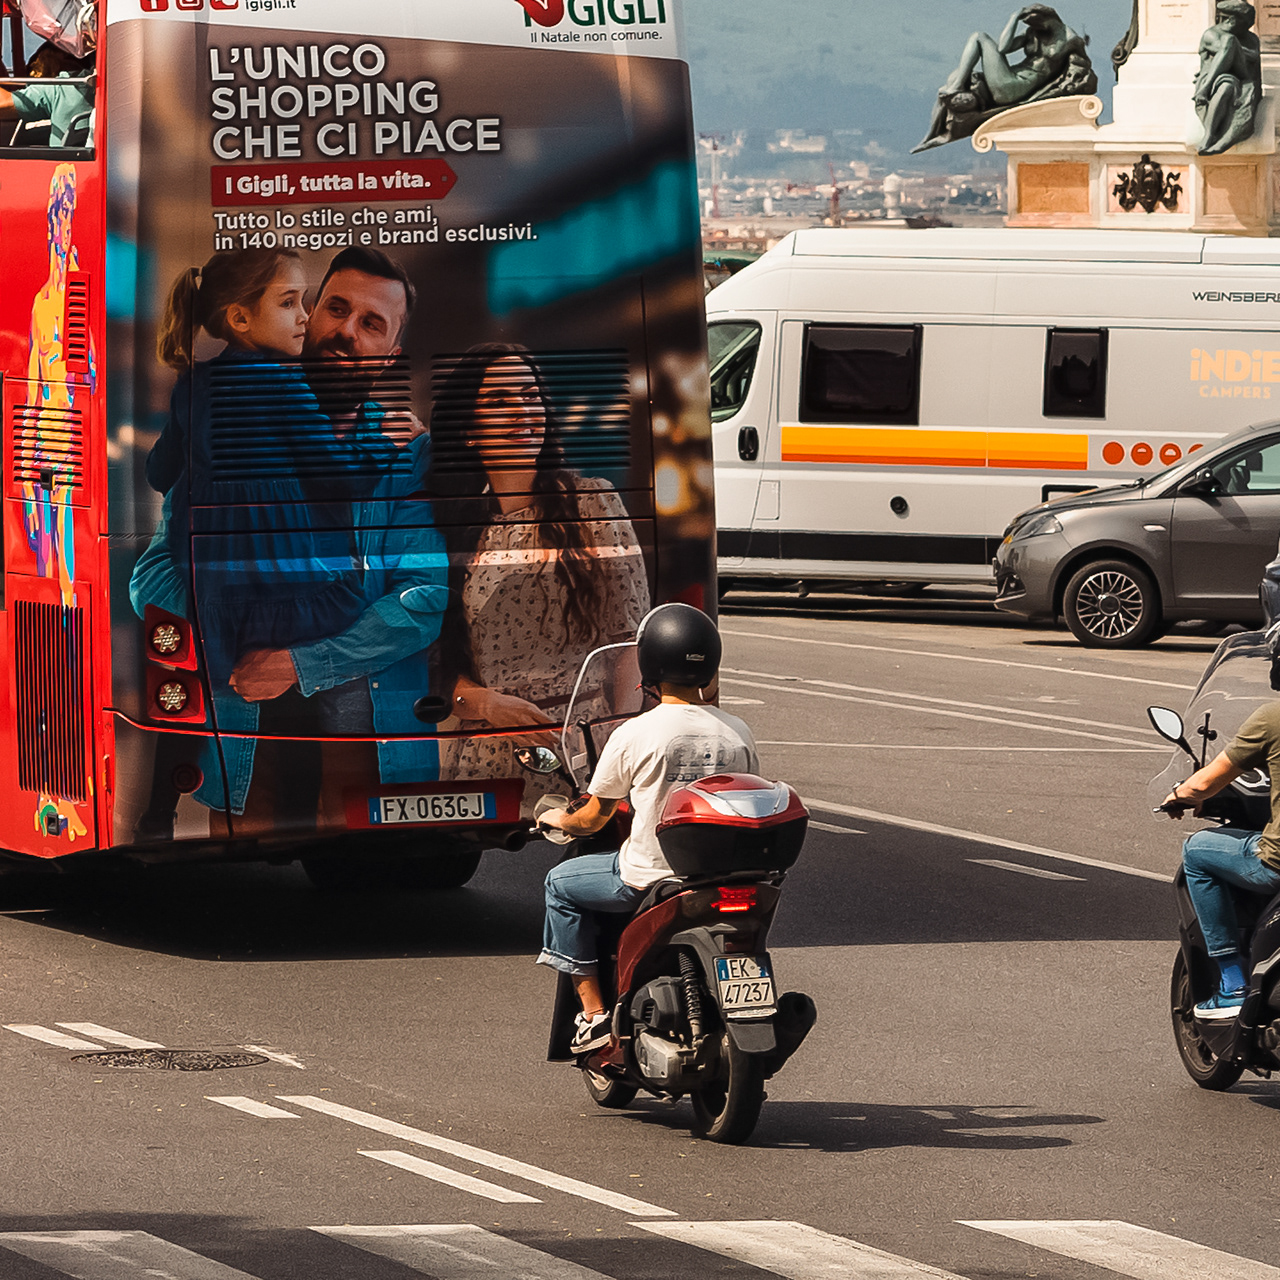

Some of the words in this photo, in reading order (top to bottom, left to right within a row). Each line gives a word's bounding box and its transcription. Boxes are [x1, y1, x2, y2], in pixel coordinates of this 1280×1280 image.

[530, 32, 538, 43] Il
[541, 31, 581, 43] Natale
[584, 33, 607, 42] non
[611, 30, 663, 41] comune.
[209, 43, 386, 81] L'UNICO
[211, 80, 439, 120] SHOPPING
[212, 124, 302, 160] CHE
[316, 122, 357, 156] CI
[375, 118, 500, 154] PIACE
[225, 177, 232, 194] I
[237, 175, 296, 197] Gigli,
[300, 173, 353, 193] tutta
[358, 172, 377, 190] la
[381, 170, 431, 190] vita.
[214, 211, 269, 230] Tutto
[276, 211, 295, 228] lo
[301, 208, 345, 228] stile
[351, 208, 388, 226] che
[394, 205, 439, 227] ami,
[215, 233, 233, 251] in
[239, 232, 277, 250] 140
[283, 228, 354, 251] negozi
[360, 232, 372, 246] e
[378, 226, 439, 246] brand
[445, 222, 538, 244] esclusivi.
[1199, 385, 1271, 399] CAMPERS
[729, 959, 750, 977] EK
[725, 982, 770, 1004] 47237
